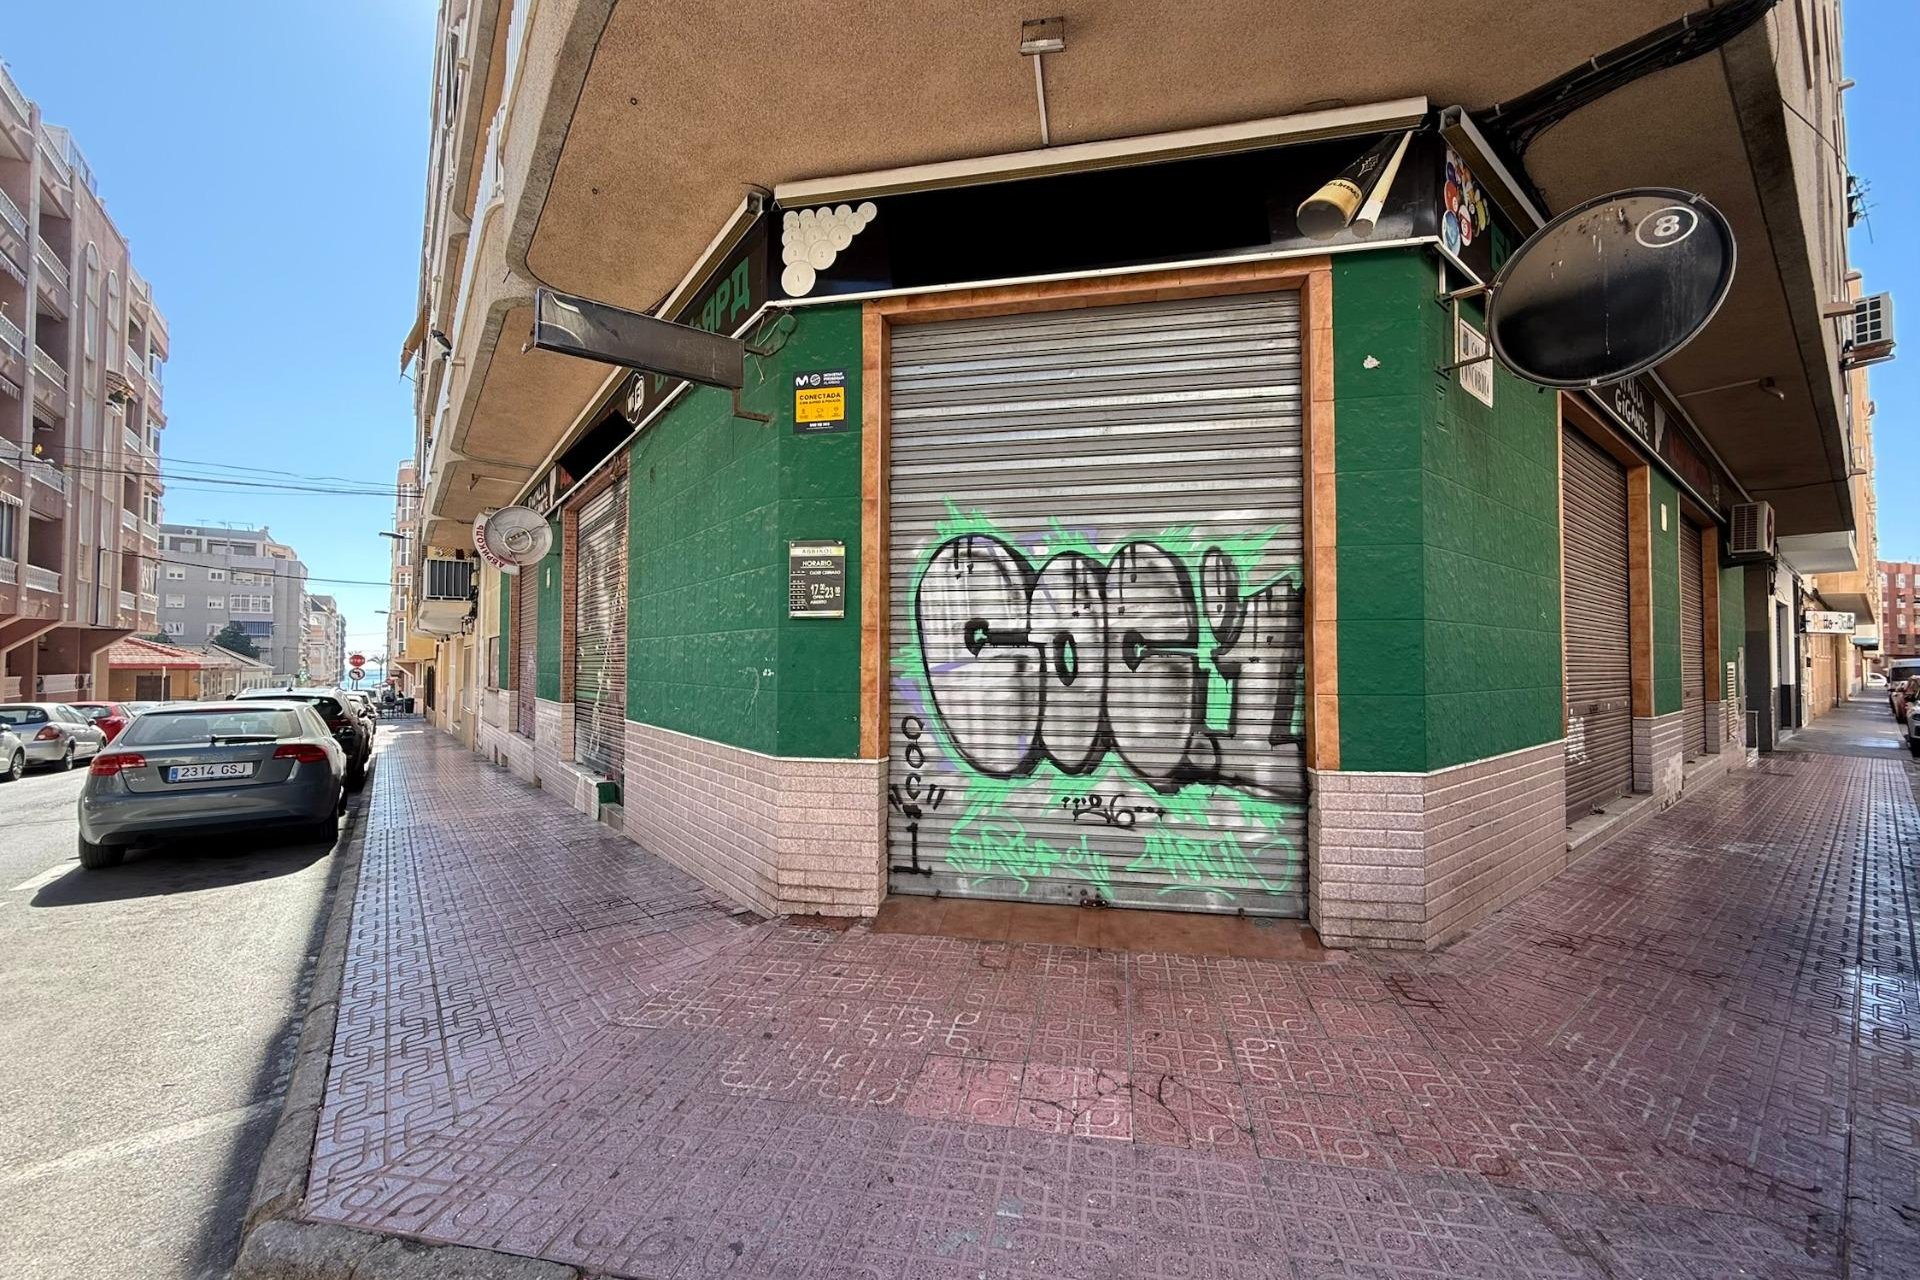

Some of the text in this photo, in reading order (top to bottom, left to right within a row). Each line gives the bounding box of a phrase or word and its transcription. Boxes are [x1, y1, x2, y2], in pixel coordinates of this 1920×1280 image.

[1653, 215, 1680, 237] 8
[799, 393, 841, 401] CONECTADA
[475, 524, 506, 569] АБРИКОЛЬ
[825, 587, 834, 598] 23
[180, 764, 246, 779] 2314 GSJ
